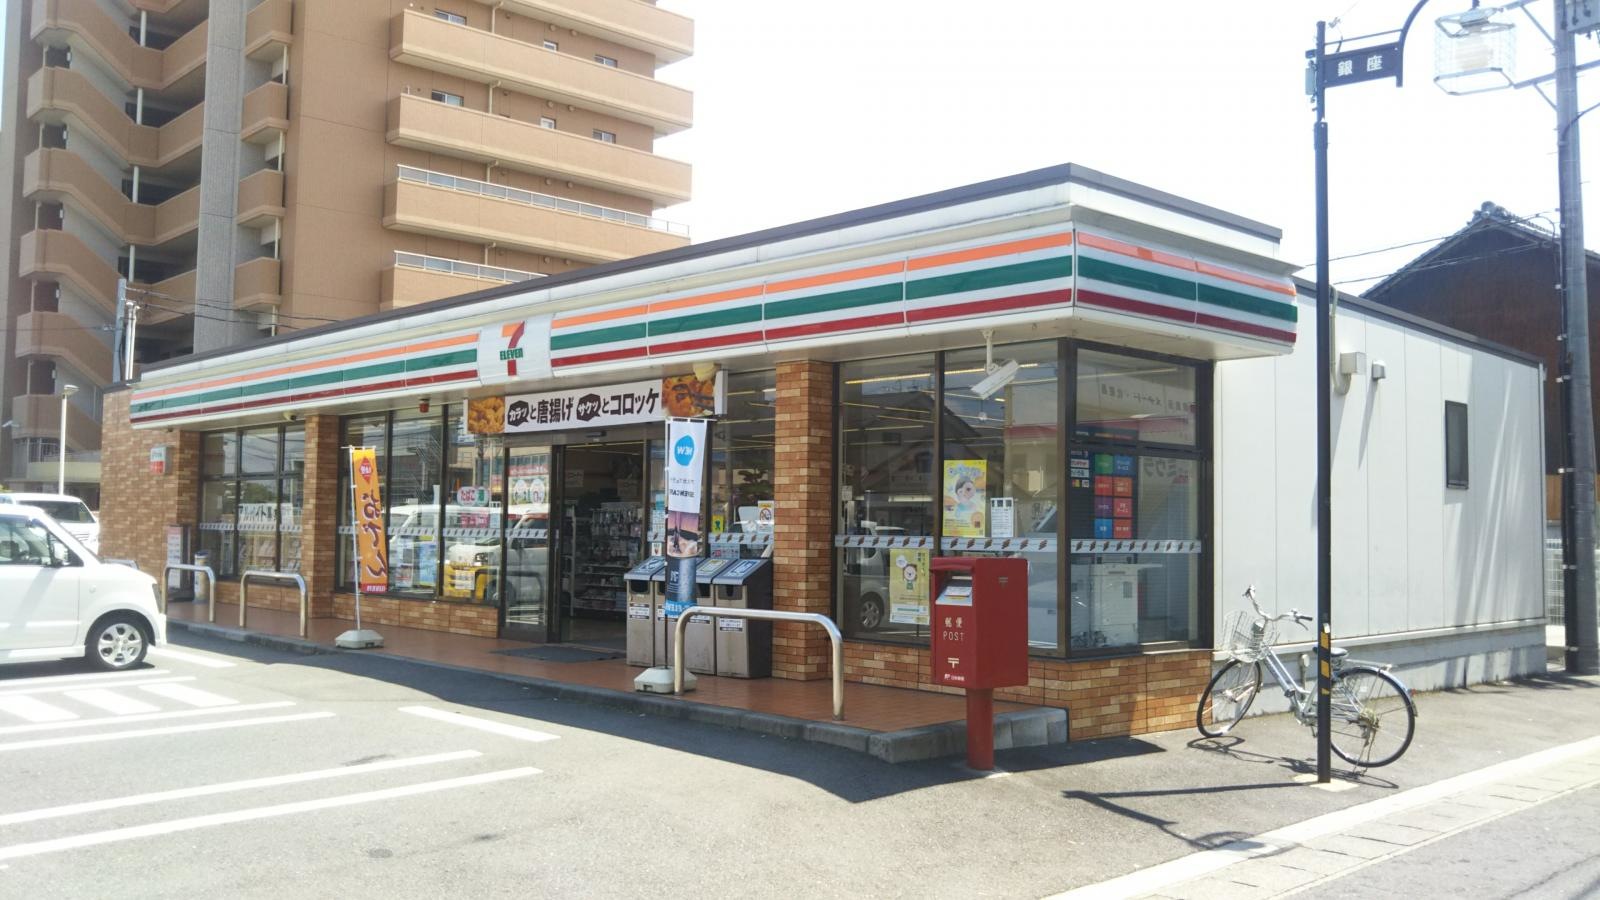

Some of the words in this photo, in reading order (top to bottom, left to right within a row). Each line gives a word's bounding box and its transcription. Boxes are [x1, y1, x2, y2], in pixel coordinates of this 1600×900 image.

[1337, 54, 1384, 77] 銀座
[499, 348, 524, 361] ELEVEN
[502, 321, 526, 376] 7
[508, 397, 574, 425] カラッと唐揚げ
[577, 387, 660, 417] サクッとコロッケ
[460, 489, 476, 501] たばこ
[361, 489, 387, 578] おでん
[944, 617, 963, 628] 郵便
[943, 630, 965, 641] POST
